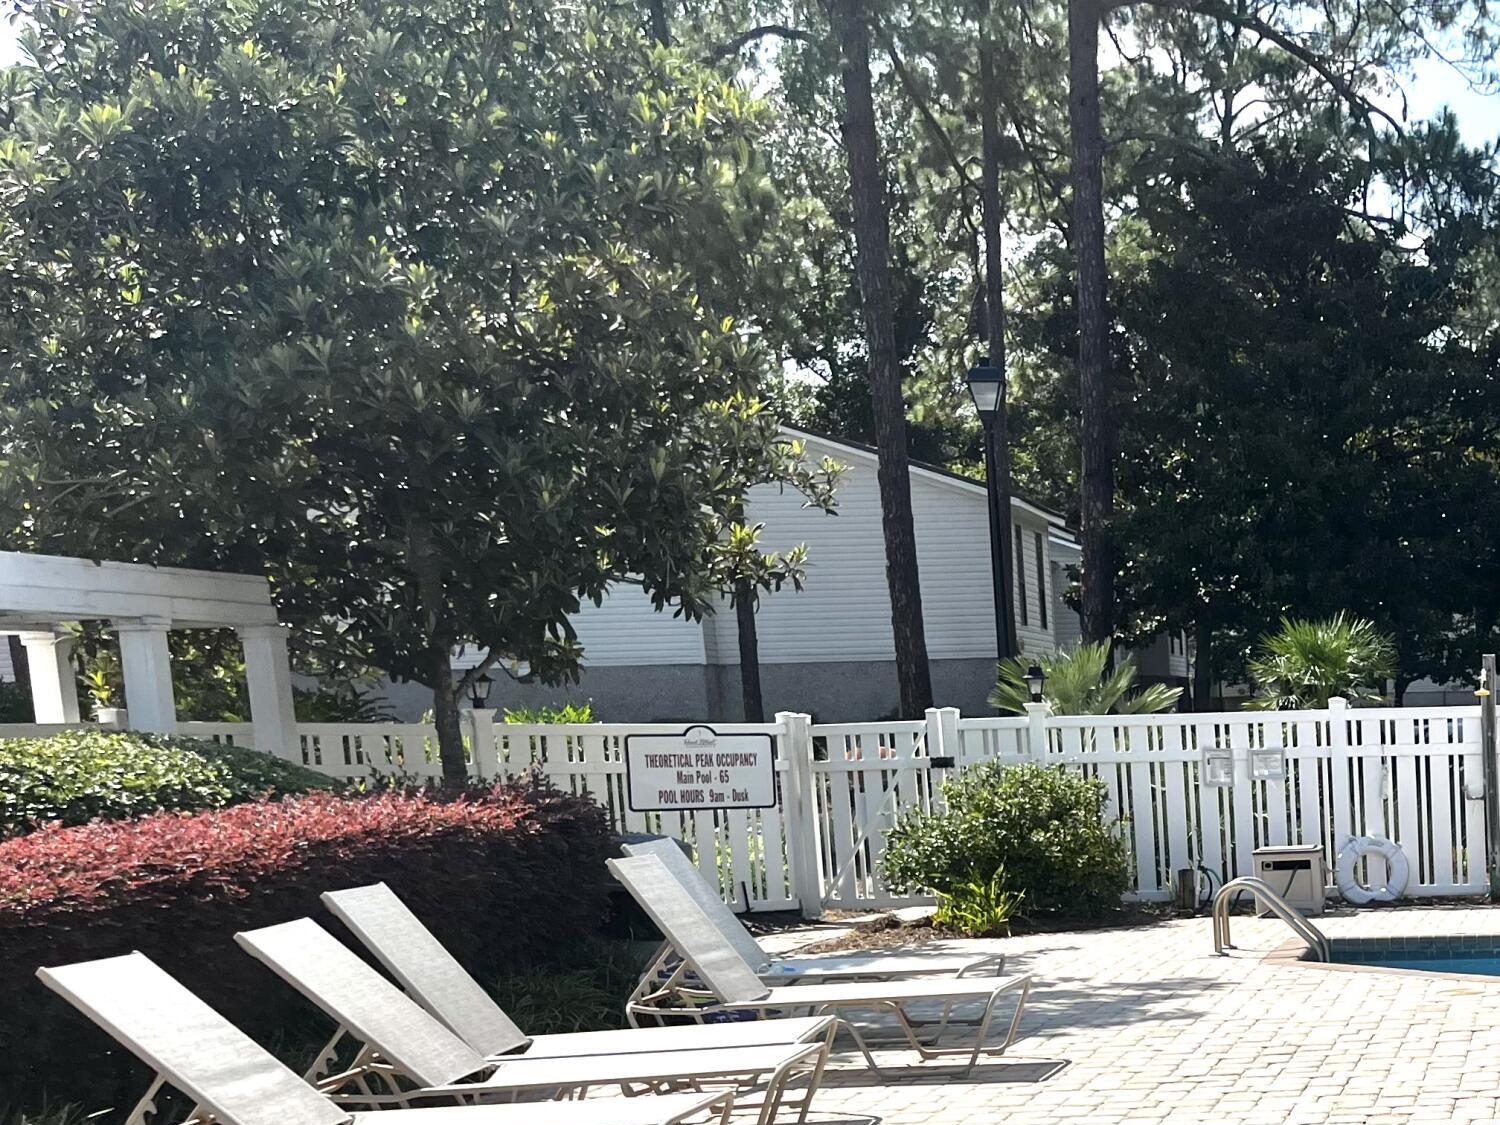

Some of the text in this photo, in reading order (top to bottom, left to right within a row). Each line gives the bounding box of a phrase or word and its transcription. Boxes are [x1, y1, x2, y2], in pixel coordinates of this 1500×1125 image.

[645, 753, 757, 768] THEORETICAL PEAK OCCUPANCY
[677, 772, 694, 784] Main
[696, 771, 712, 784] Pool
[720, 770, 729, 783] 65
[659, 790, 678, 804] POOL
[680, 790, 704, 803] HOURS
[709, 790, 725, 803] 9am
[732, 788, 749, 802] Dusk
